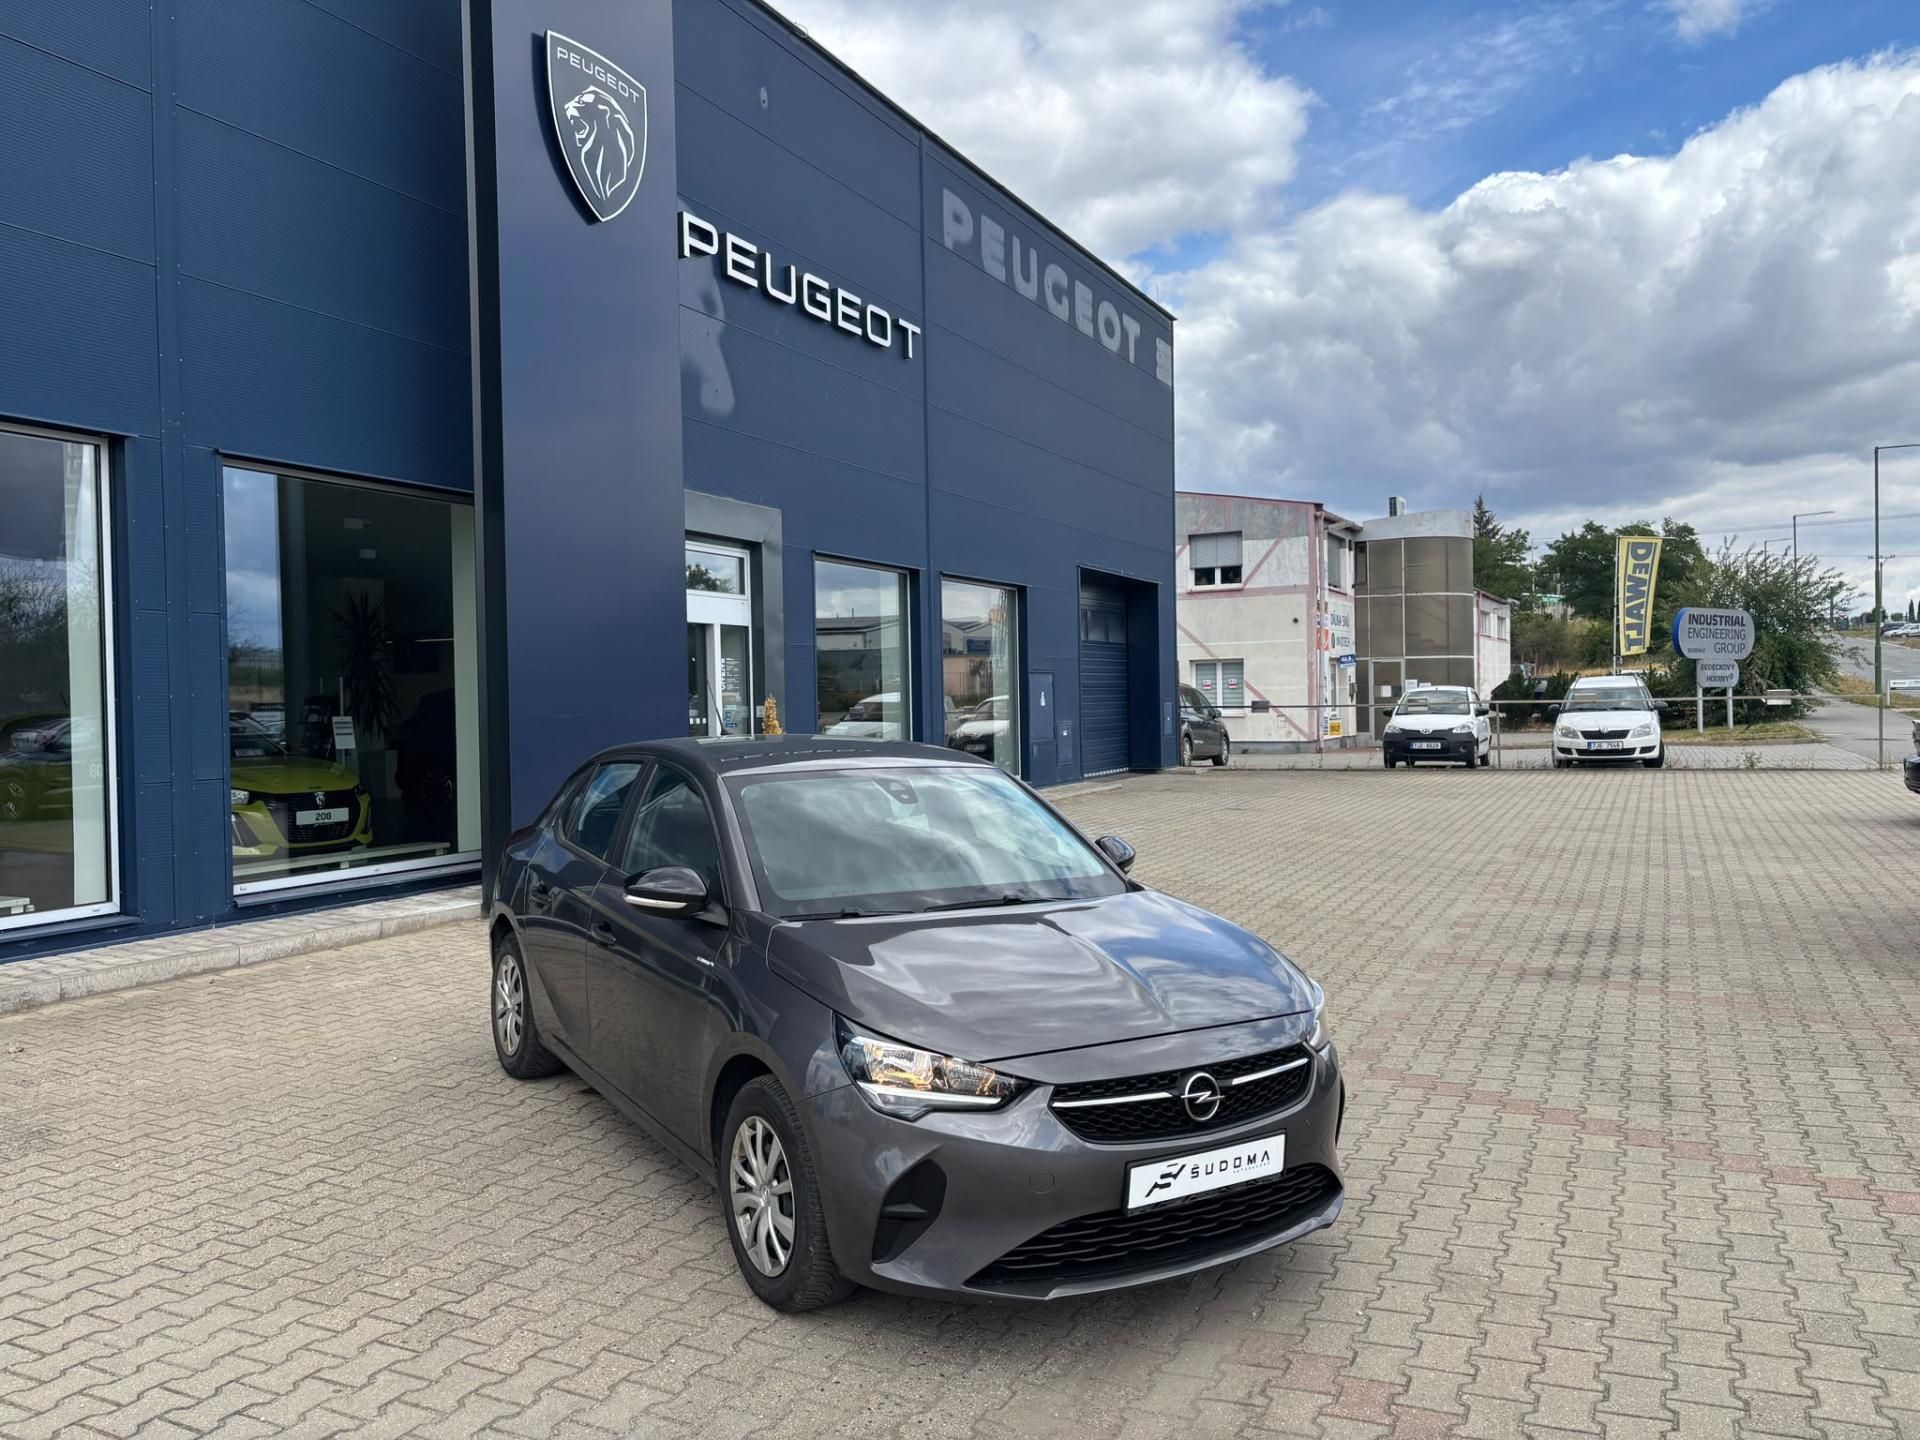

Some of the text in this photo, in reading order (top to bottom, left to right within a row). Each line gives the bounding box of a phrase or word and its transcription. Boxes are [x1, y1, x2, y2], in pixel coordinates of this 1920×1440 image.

[557, 46, 640, 104] PEUGEOT
[942, 187, 1141, 365] PEUGEOT
[681, 210, 921, 360] PEUGEOT
[1688, 613, 1746, 627] INDUSTRIAL
[1687, 627, 1746, 640] ENGINEERING
[1713, 642, 1746, 654] GROUP
[315, 811, 332, 821] 208
